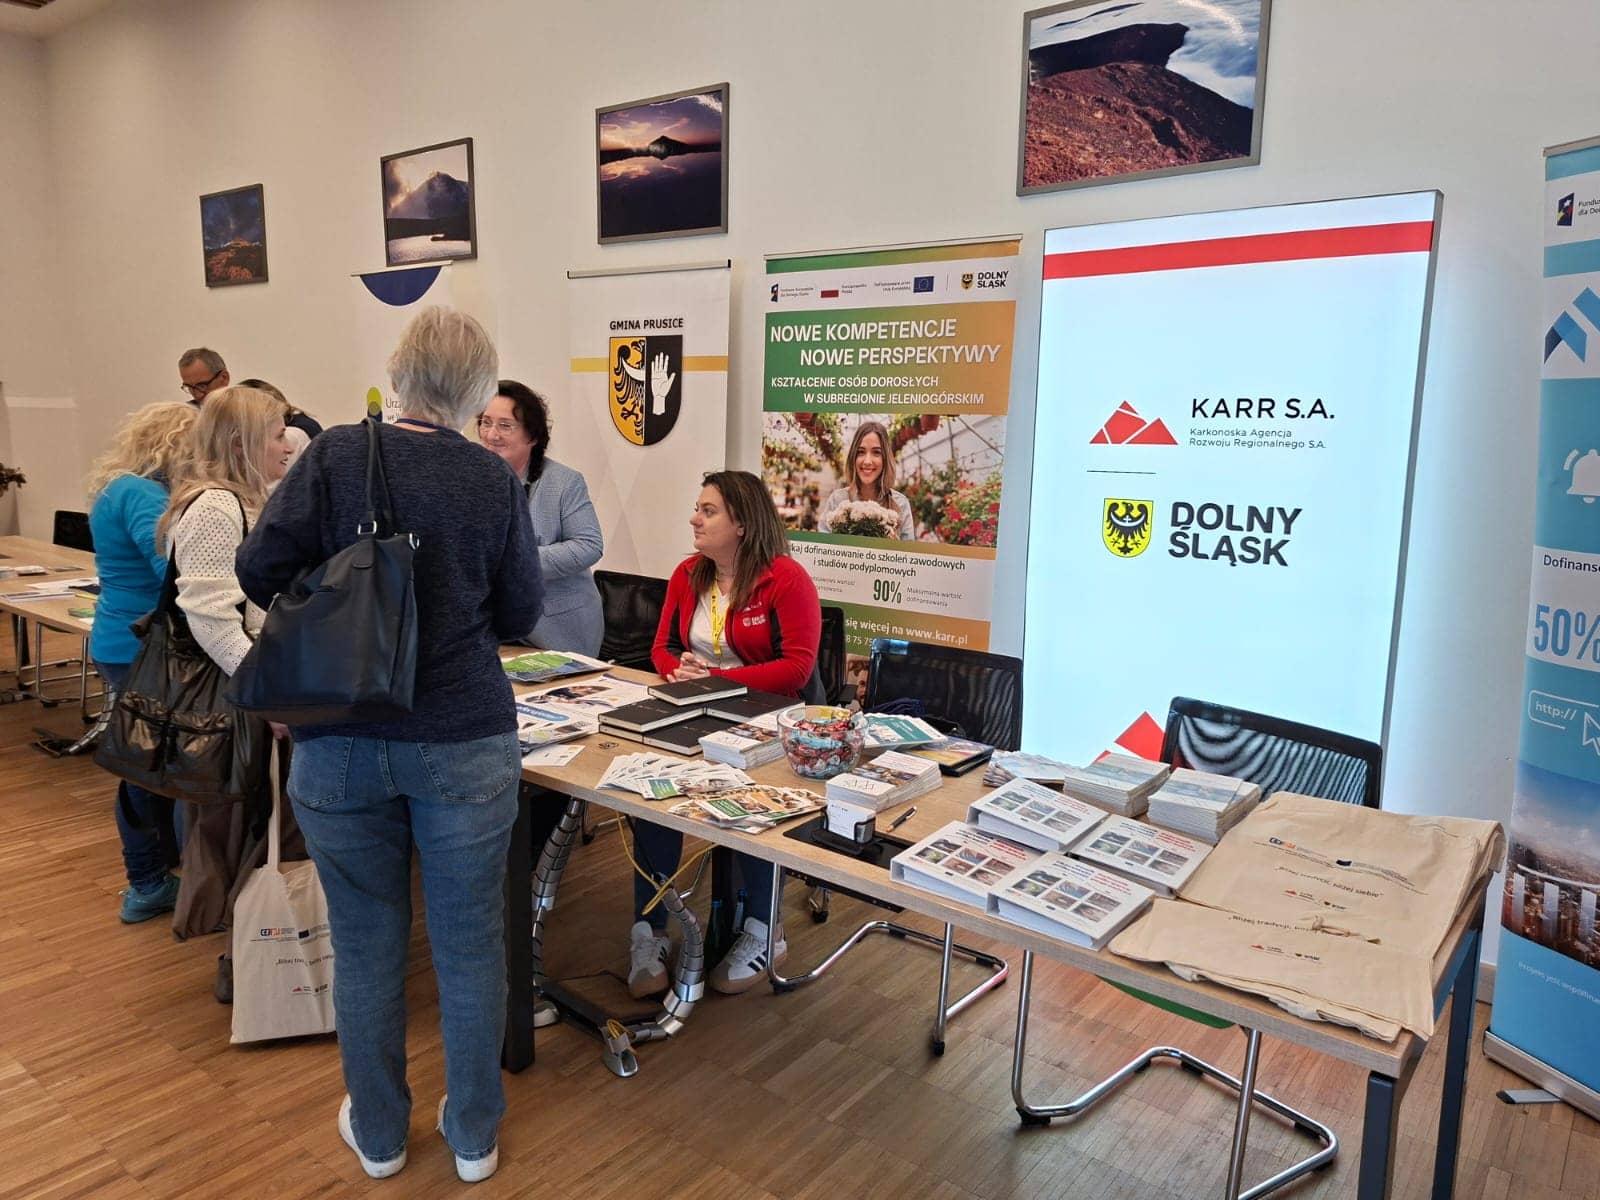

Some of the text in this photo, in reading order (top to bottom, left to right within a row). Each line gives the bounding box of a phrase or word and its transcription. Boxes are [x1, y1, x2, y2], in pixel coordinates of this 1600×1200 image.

[977, 270, 1009, 280] DOLNY
[609, 318, 684, 331] GMINA PRUSICE
[770, 318, 957, 343] NOWE KOMPETENCJE
[800, 344, 1001, 366] NOWE PERSPEKTYWY
[771, 374, 939, 388] KSZTAŁCENIE OSÓB DOROSŁYCH
[804, 391, 984, 405] W SUBREGIONIE JELENIOGÓRSKIM
[1191, 398, 1335, 419] KARR S.A.
[1189, 428, 1292, 439] Karkonoska Agencja
[1189, 438, 1326, 450] Rozwoju Regionalnego S.A.
[1170, 501, 1303, 535] DOLNY
[1167, 526, 1290, 567] ŚLĄSK
[804, 544, 865, 560] dofinansowanie
[866, 551, 877, 561] do
[877, 553, 908, 564] szkoleń
[909, 556, 966, 571] zawodowych
[1543, 554, 1600, 573] Dofinans
[817, 558, 848, 569] studiów
[849, 563, 917, 578] podyplomowych
[873, 579, 902, 605] 90%
[846, 617, 968, 646] się więcej na www.karr.pl
[1533, 603, 1600, 664] 50%
[1535, 701, 1577, 721] http://
